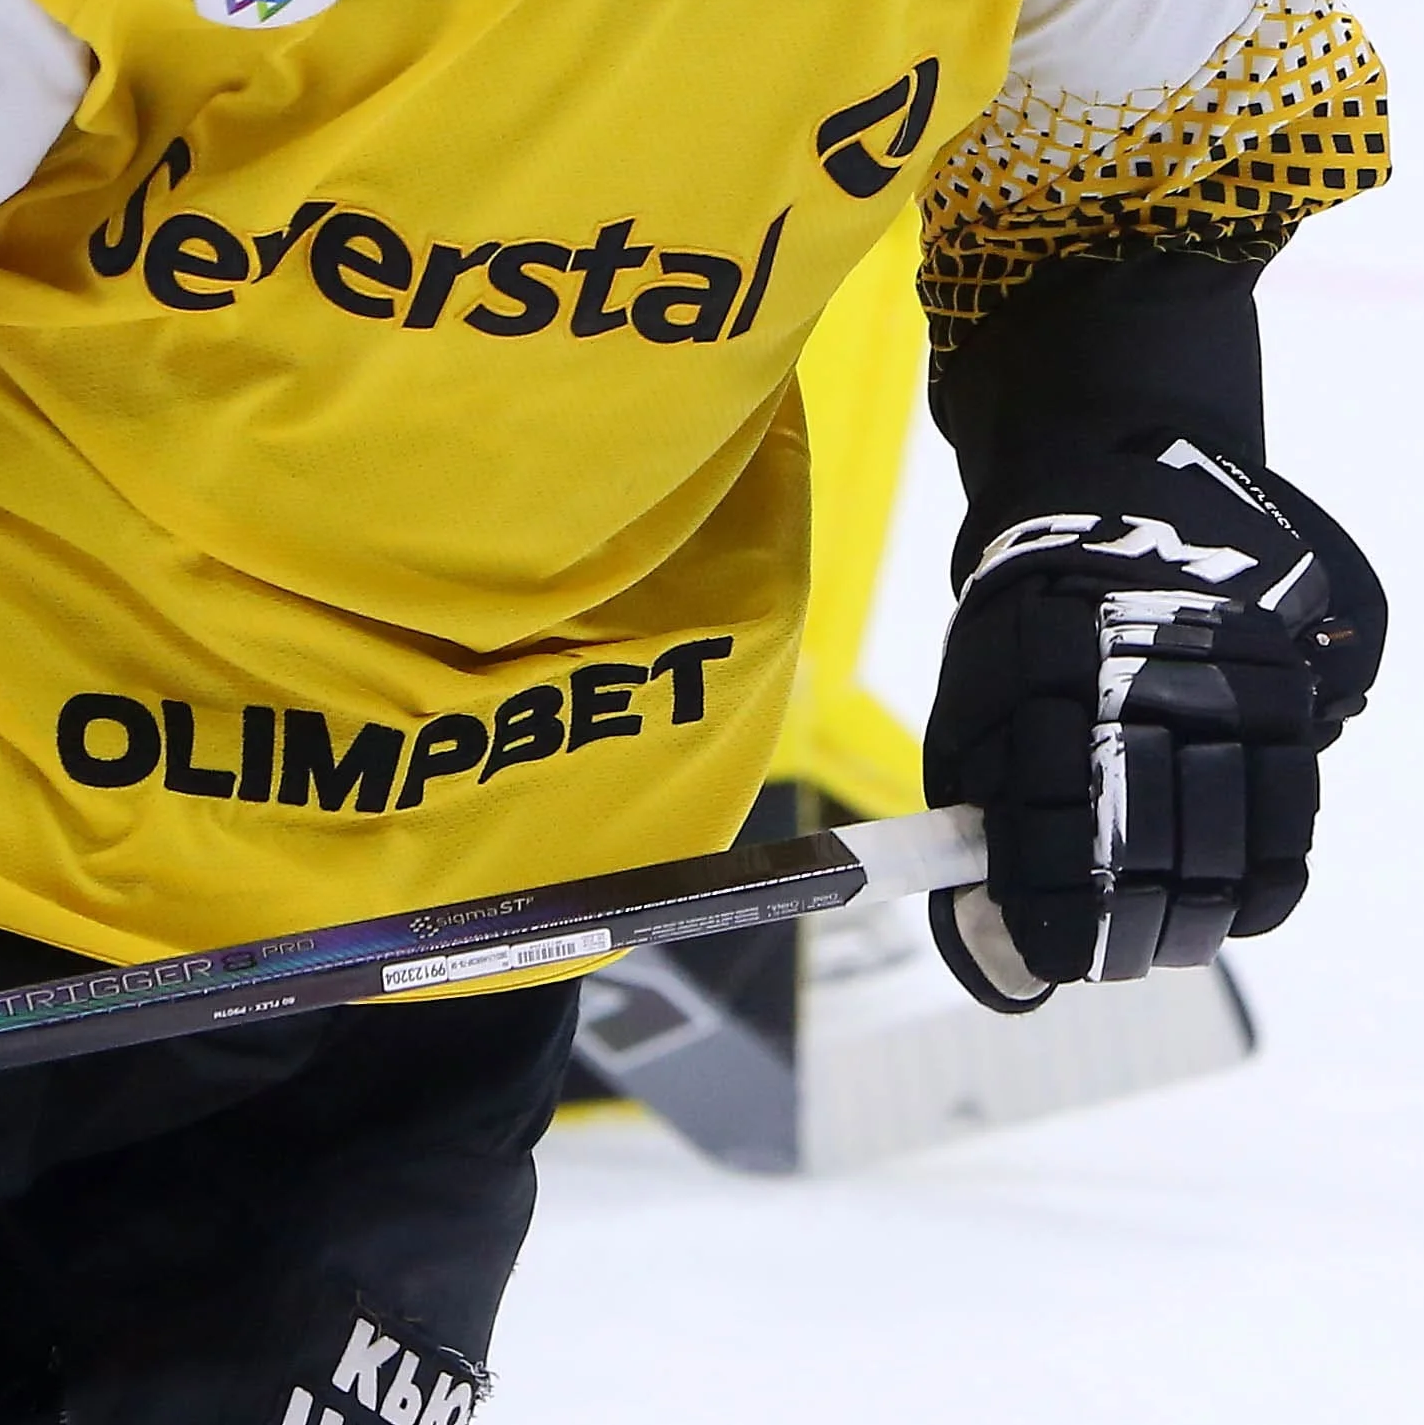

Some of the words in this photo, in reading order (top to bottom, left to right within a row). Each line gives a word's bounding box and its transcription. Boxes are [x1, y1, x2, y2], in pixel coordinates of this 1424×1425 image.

[56, 635, 733, 814] OLIMPBET
[261, 937, 315, 959] PRO
[383, 962, 446, 985] 99123204
